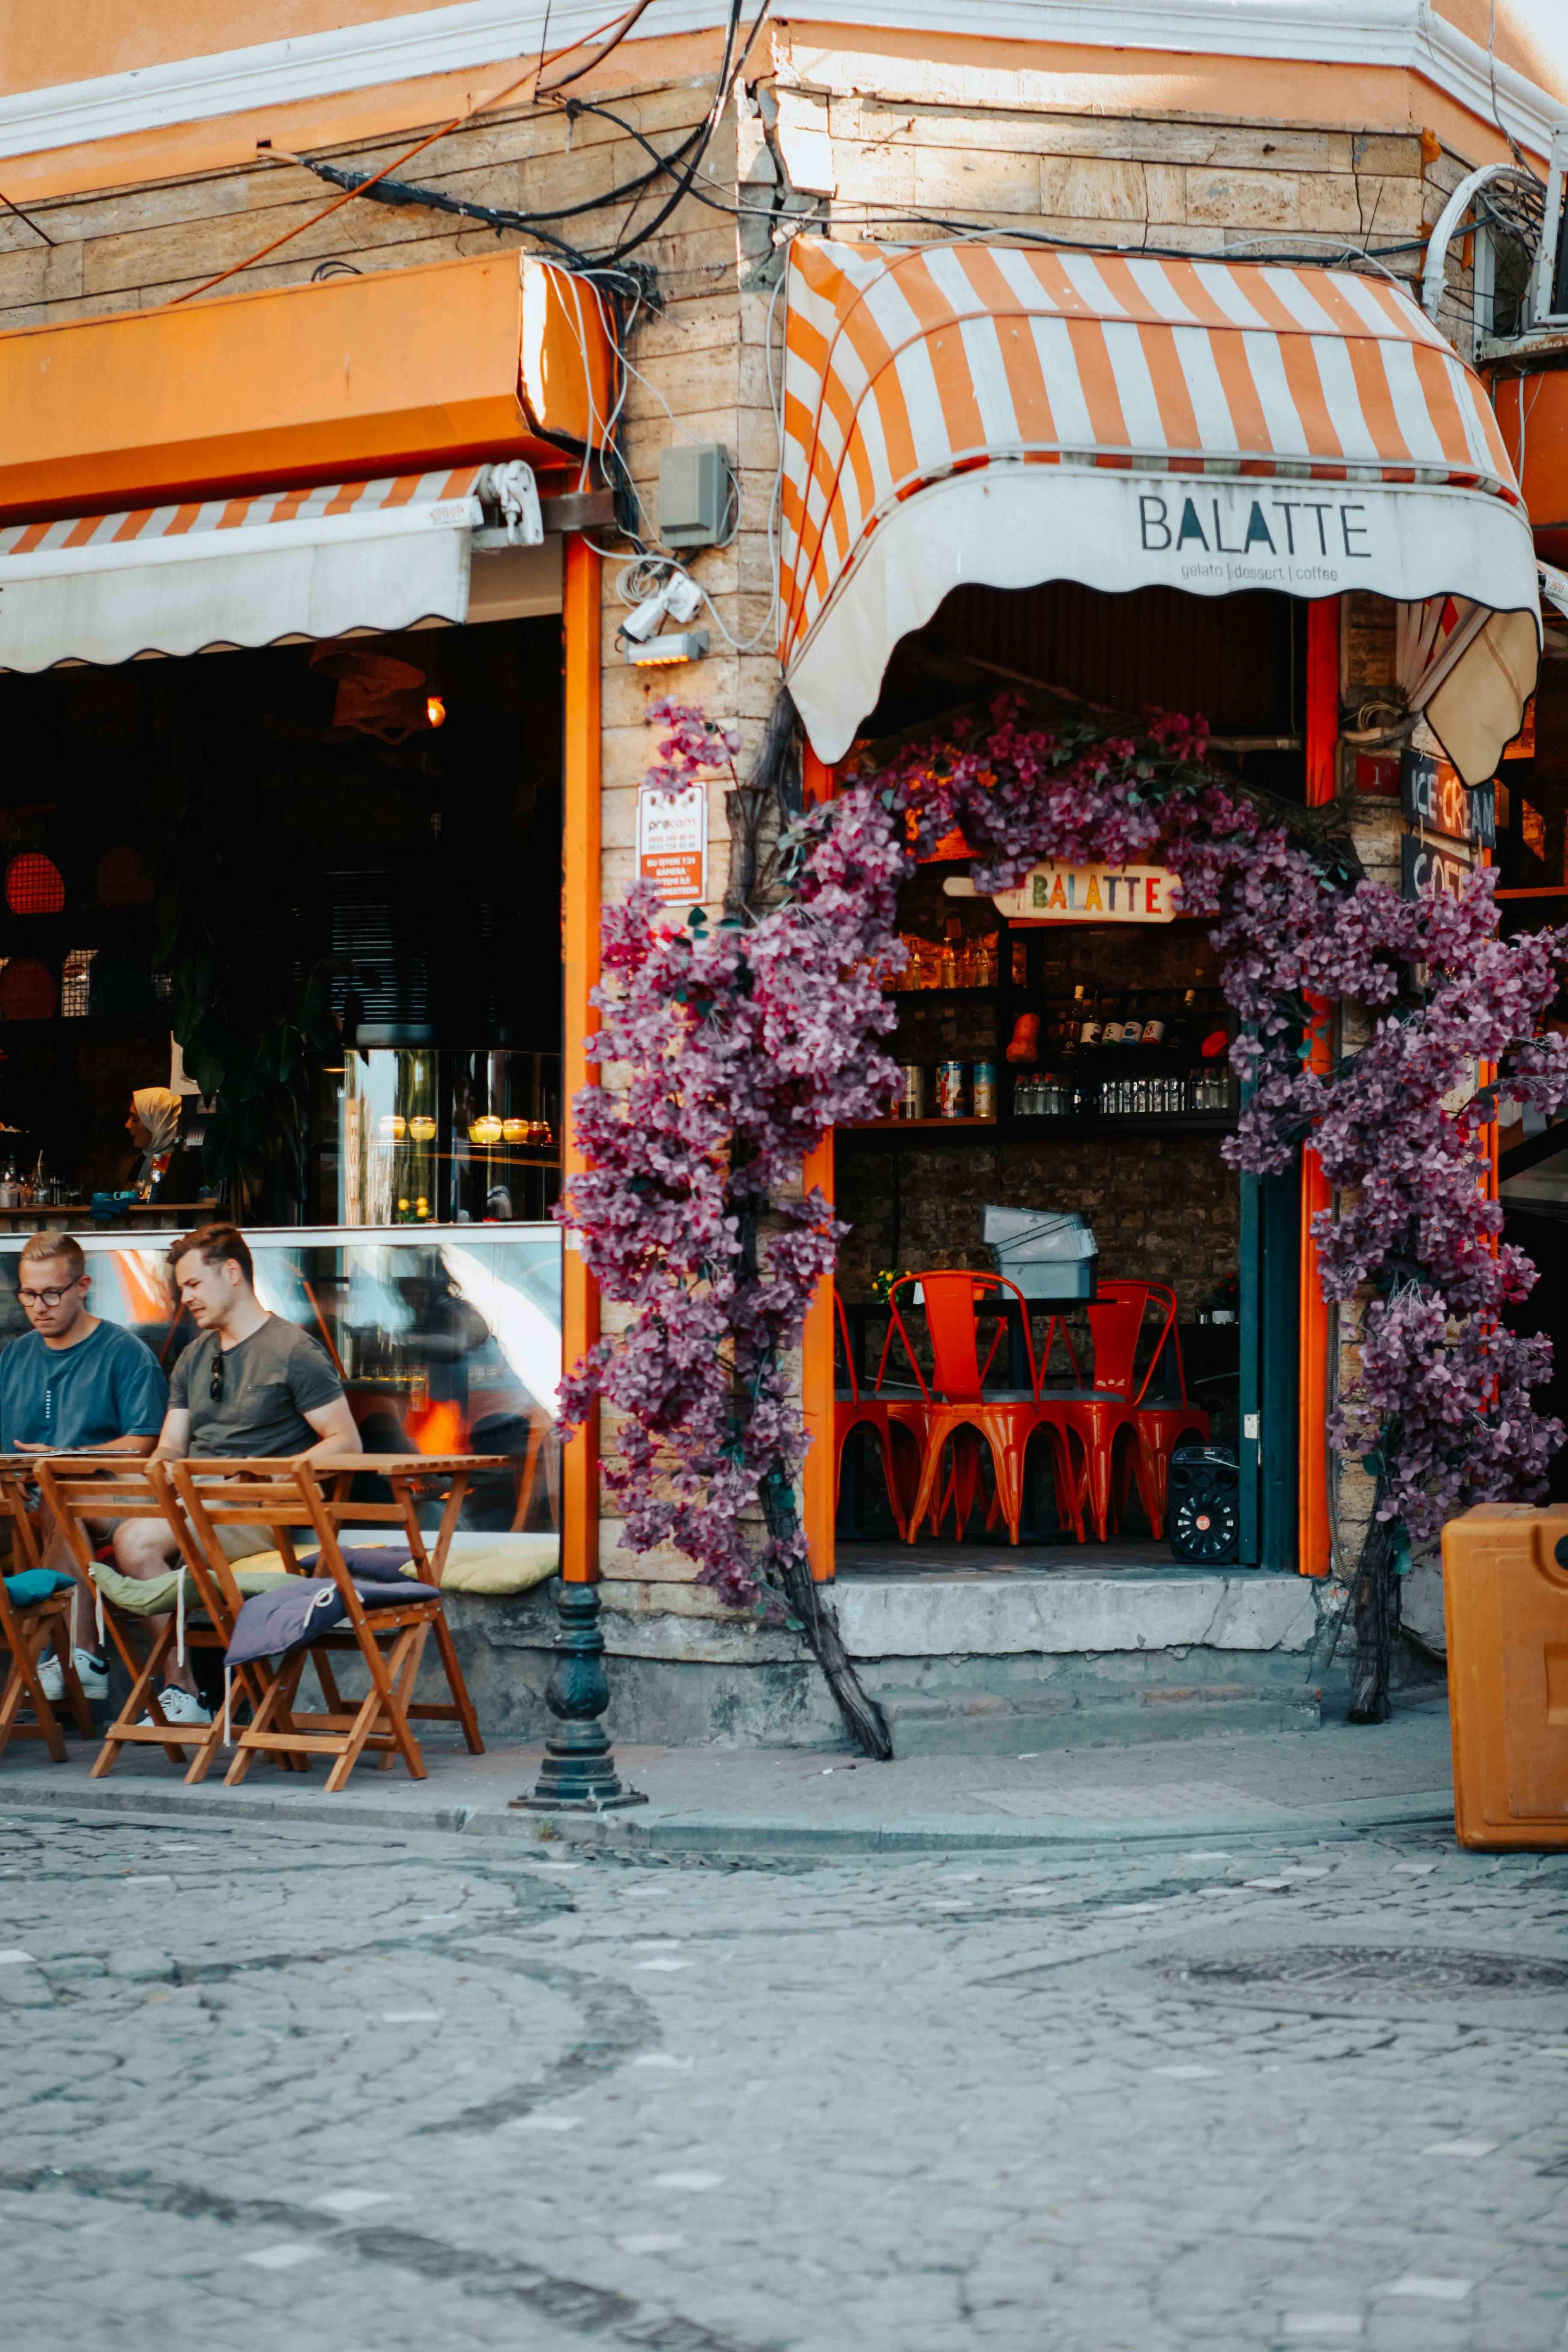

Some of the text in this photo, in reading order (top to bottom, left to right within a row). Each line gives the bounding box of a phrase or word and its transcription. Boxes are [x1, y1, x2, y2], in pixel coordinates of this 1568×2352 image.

[1139, 495, 1372, 557] BALATTE
[1181, 563, 1338, 581] gelato dessert coffee
[649, 818, 696, 833] procam
[1033, 874, 1161, 914] BALATTE
